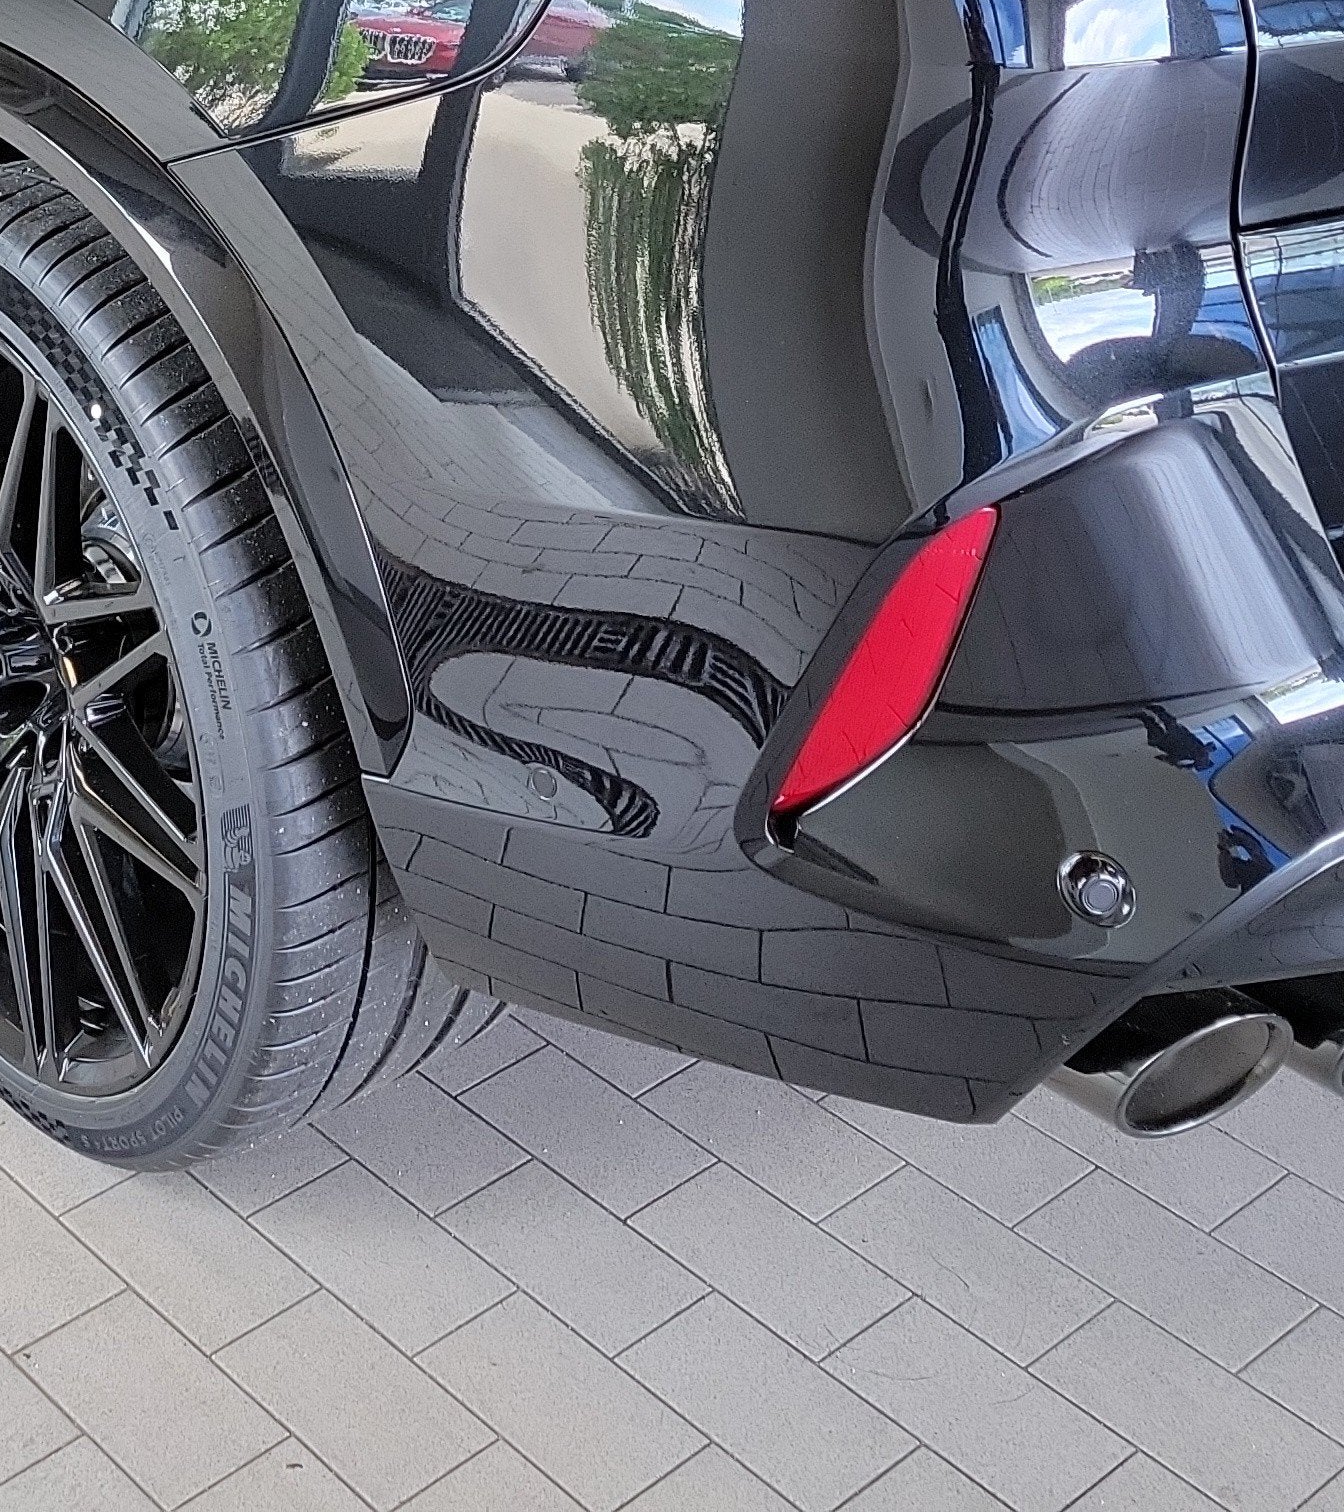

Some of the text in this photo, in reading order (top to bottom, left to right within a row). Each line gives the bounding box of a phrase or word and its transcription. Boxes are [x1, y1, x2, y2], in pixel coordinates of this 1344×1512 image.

[197, 643, 225, 740] Total Performance
[206, 641, 232, 711] MICHELIN
[184, 884, 253, 1108] MICHELIN
[103, 1129, 146, 1152] SPORT
[150, 1105, 185, 1139] PILOT
